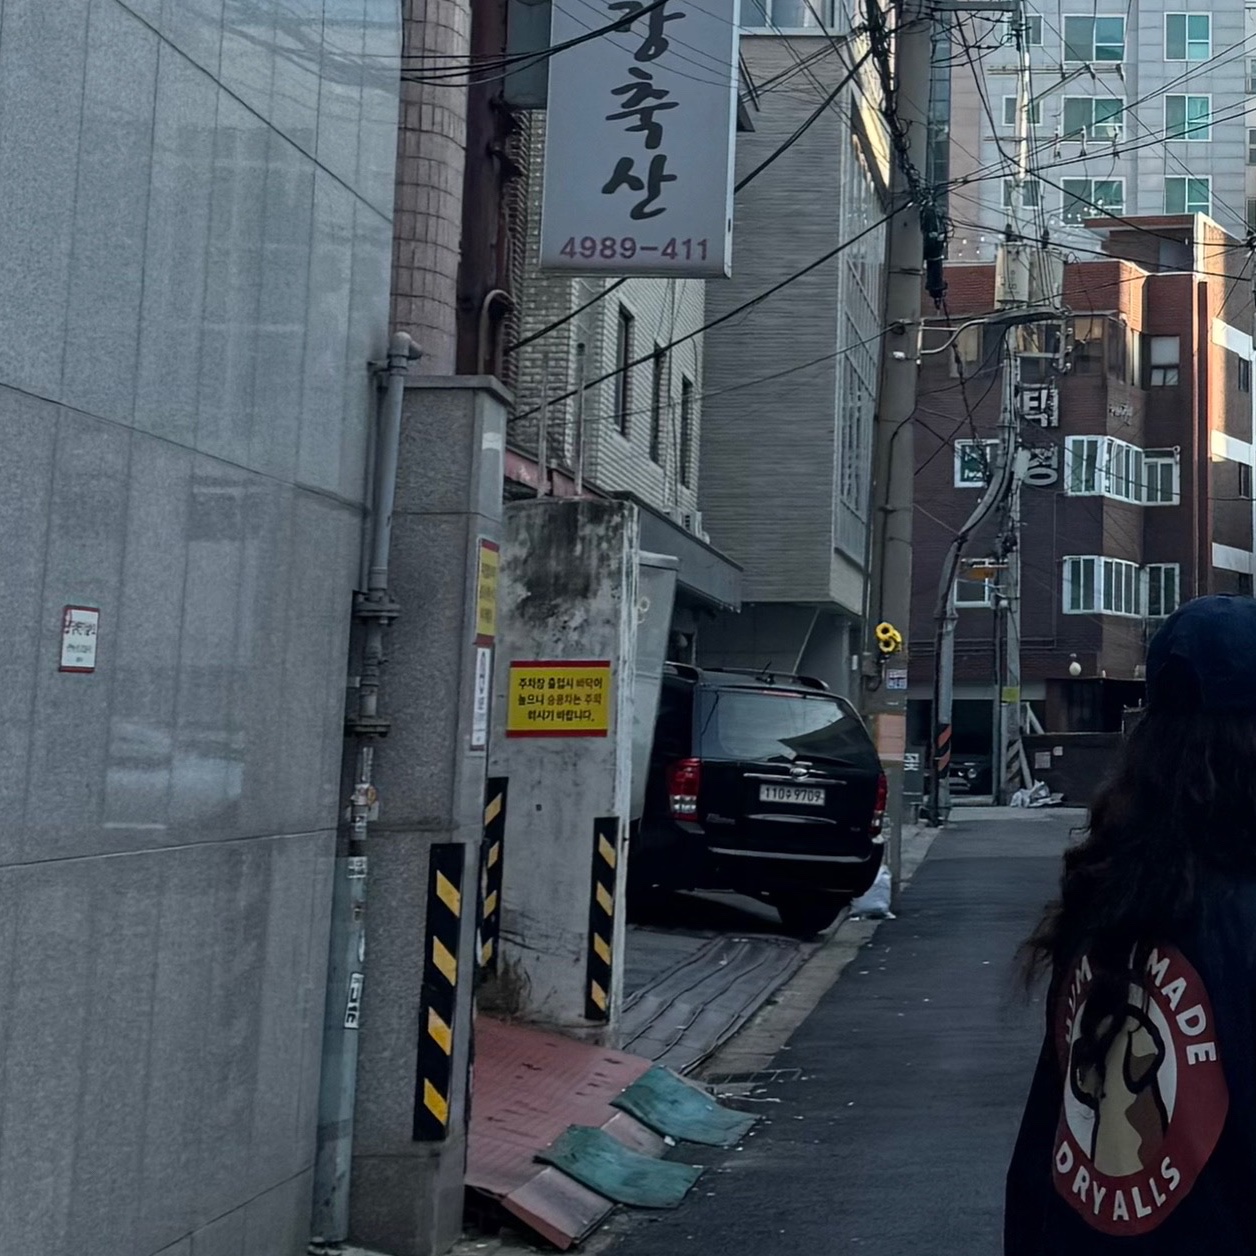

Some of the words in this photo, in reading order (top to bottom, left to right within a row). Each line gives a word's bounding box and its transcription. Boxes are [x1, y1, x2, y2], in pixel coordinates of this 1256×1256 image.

[560, 236, 708, 261] 4989-411
[519, 677, 545, 689] 주차장
[548, 677, 573, 689] 출입시
[518, 694, 544, 706] 높으니
[556, 709, 595, 721] 바랍니다.
[794, 788, 821, 802] 9709
[1146, 948, 1217, 1065] MADE
[1055, 1140, 1181, 1221] DRYALLS
